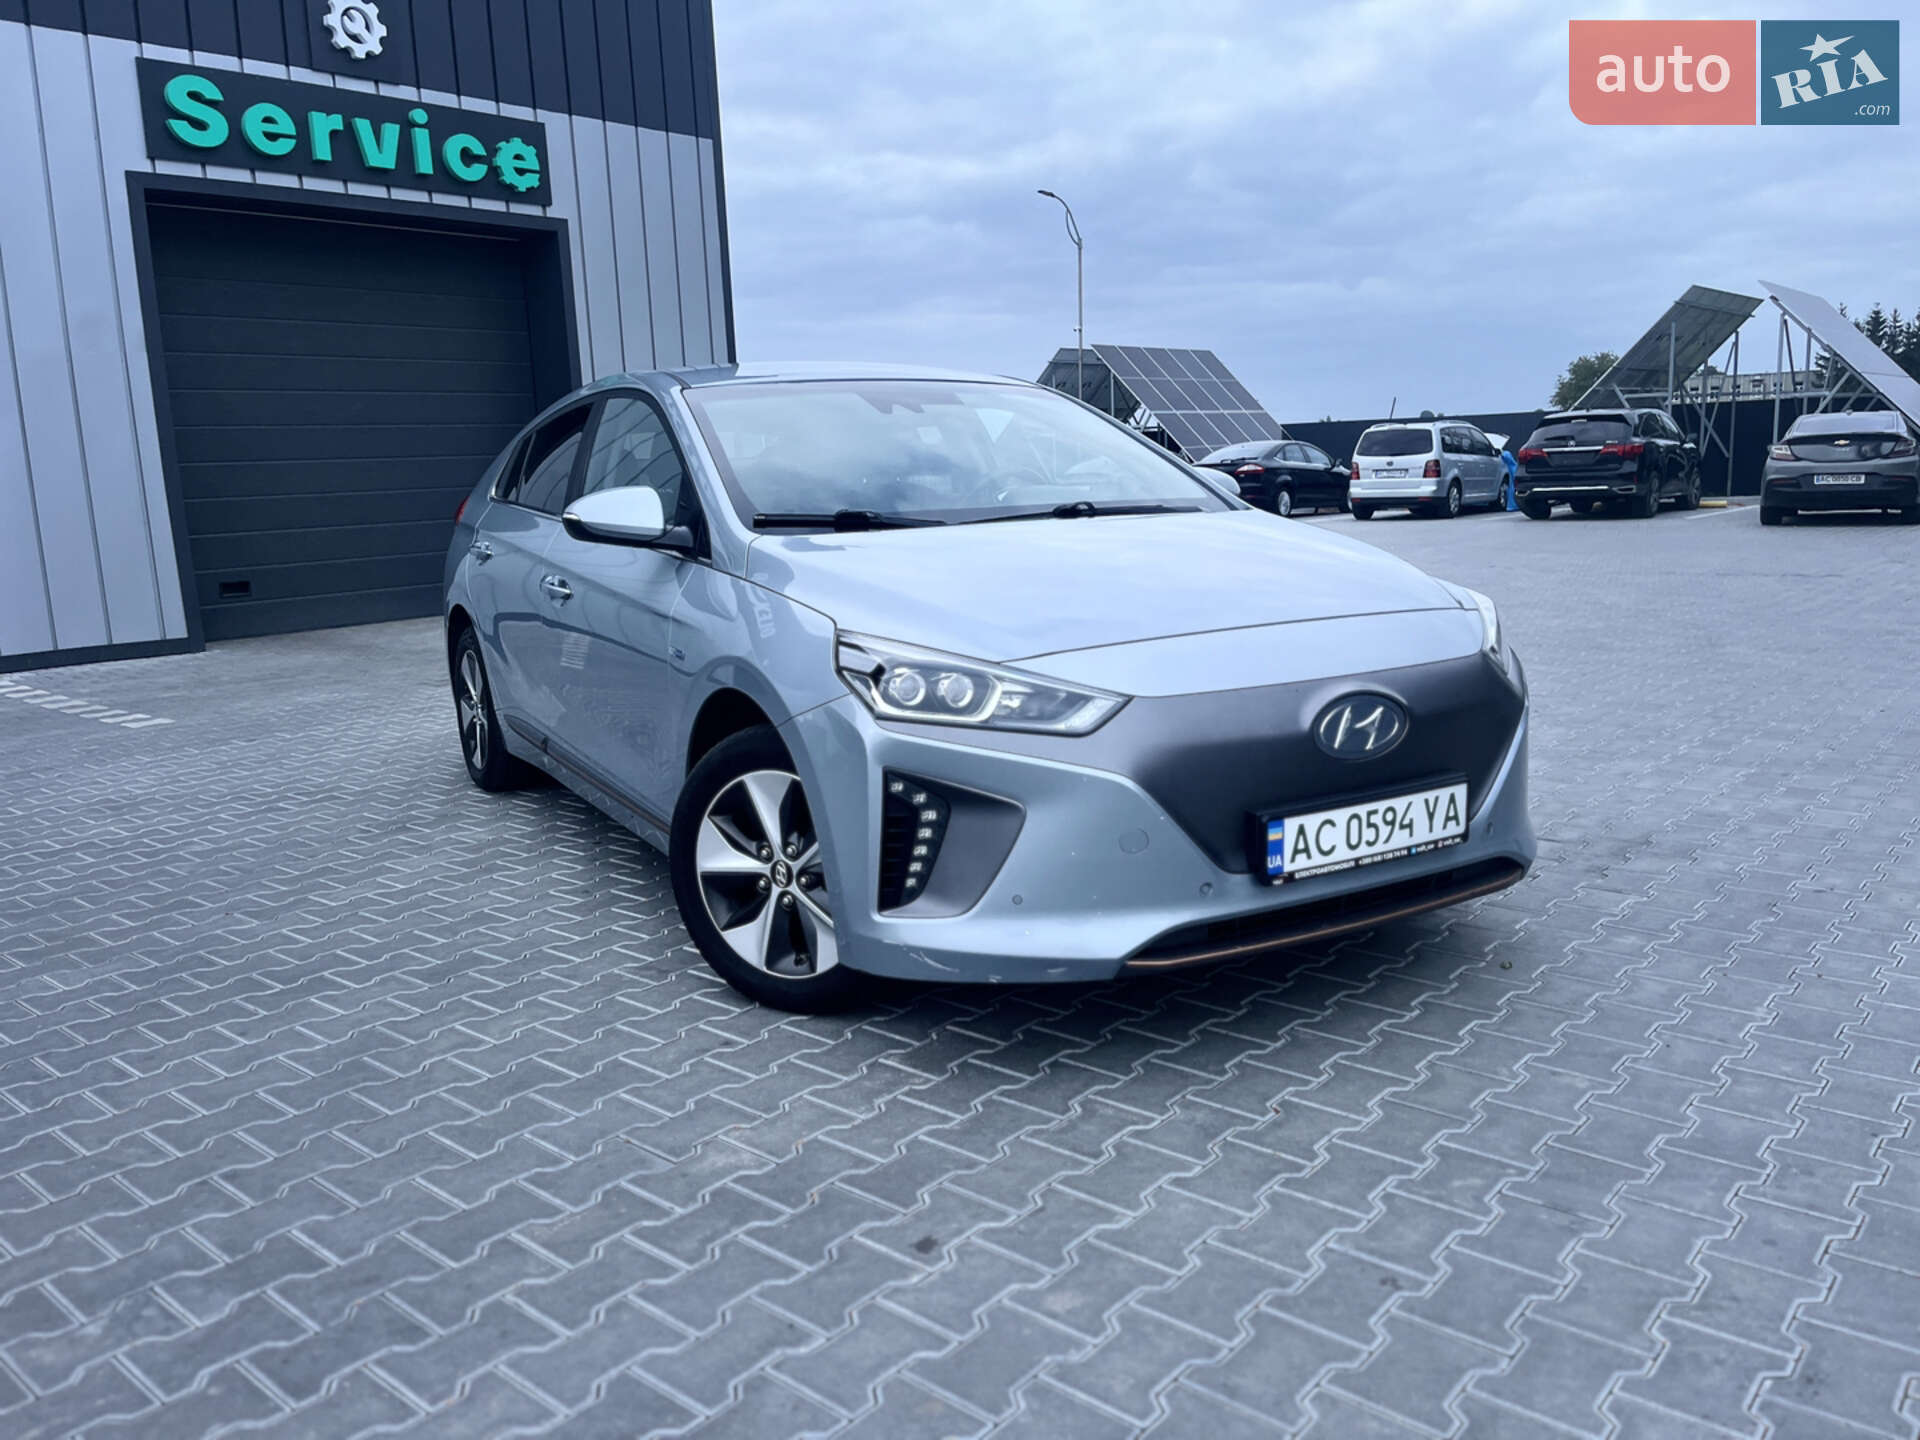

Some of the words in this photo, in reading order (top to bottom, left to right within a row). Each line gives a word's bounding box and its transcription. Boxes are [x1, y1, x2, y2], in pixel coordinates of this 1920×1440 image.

[163, 74, 541, 192] Service
[1267, 854, 1283, 868] UA
[1289, 818, 1337, 865] AC
[1346, 801, 1414, 851] 0594
[1423, 792, 1461, 833] YA
